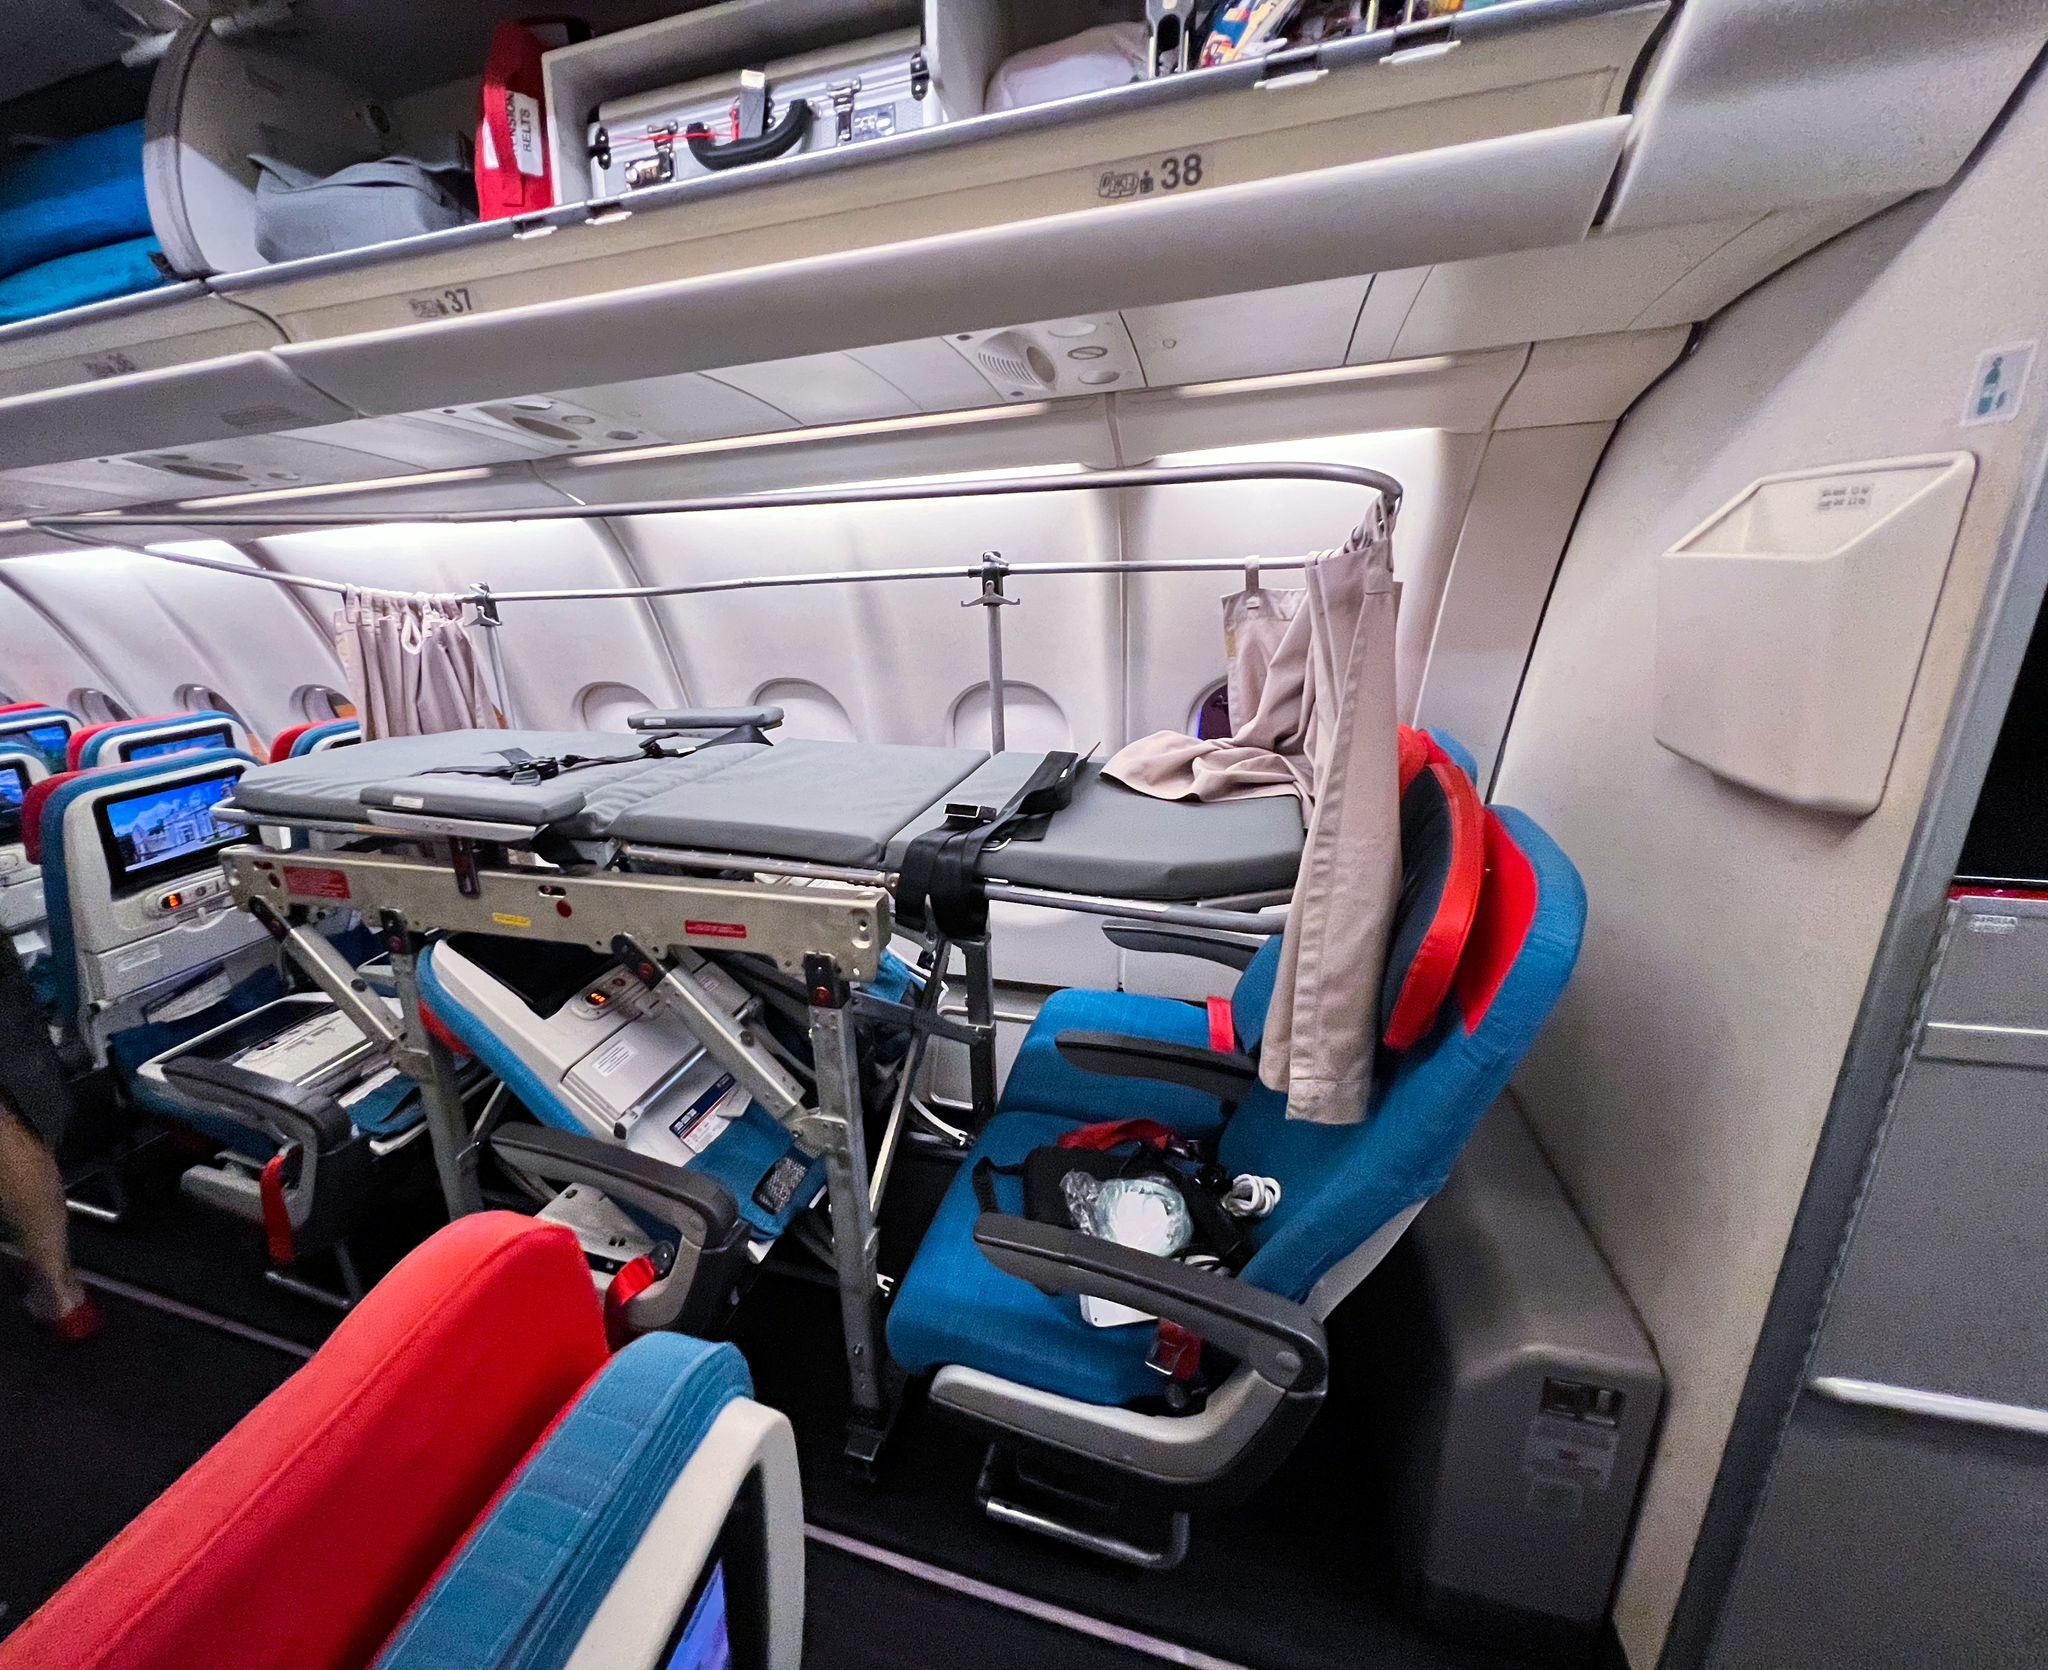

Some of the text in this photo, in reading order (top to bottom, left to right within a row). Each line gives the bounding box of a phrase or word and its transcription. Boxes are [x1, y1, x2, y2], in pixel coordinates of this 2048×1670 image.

[520, 107, 532, 152] BELTS
[1160, 152, 1203, 190] 38
[444, 288, 472, 313] 37
